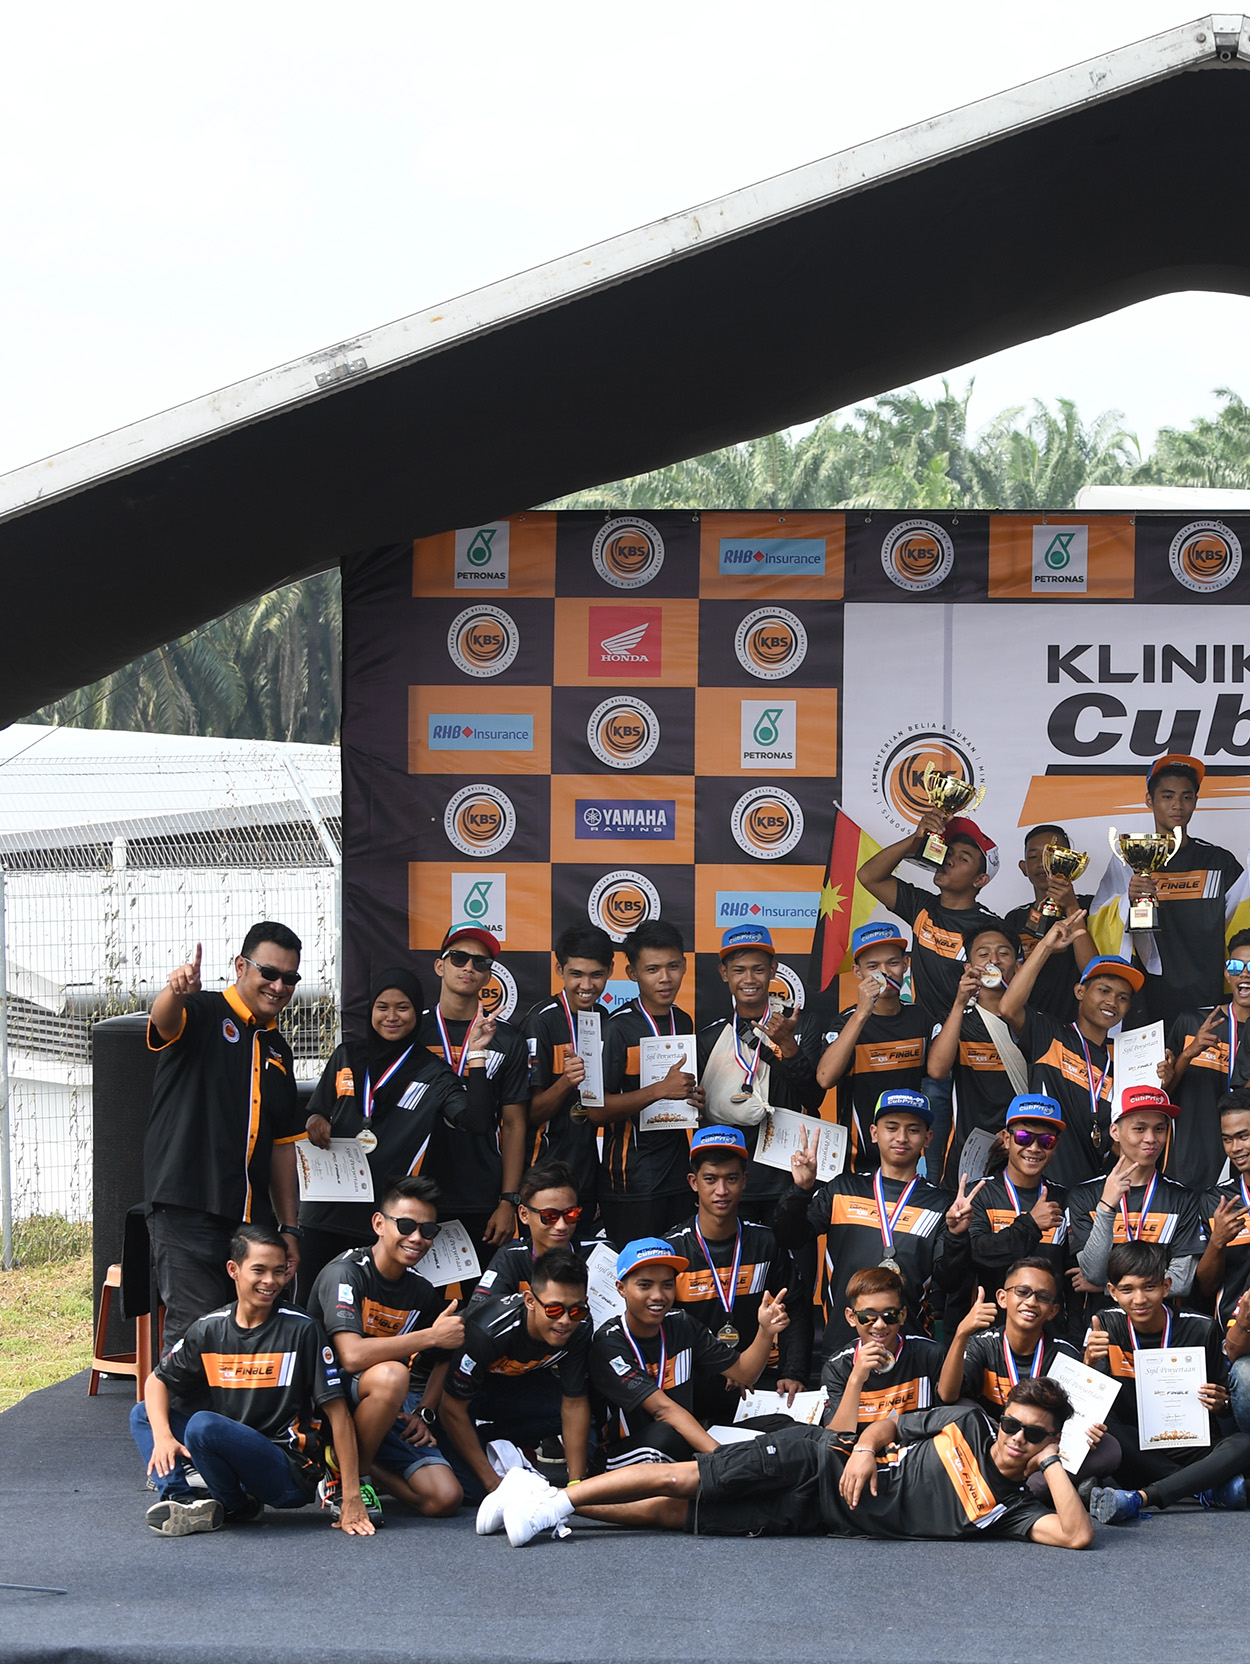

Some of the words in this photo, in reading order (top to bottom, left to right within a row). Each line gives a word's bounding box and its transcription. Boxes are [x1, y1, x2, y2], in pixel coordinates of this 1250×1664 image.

[618, 546, 645, 558] KBS
[724, 549, 753, 564] RHB
[765, 553, 821, 564] Insurance
[907, 549, 934, 561] KBS
[1195, 550, 1222, 562] KBS
[457, 572, 506, 580] PETRONAS
[1034, 575, 1084, 583] PETRONAS
[473, 635, 500, 647] KBS
[761, 637, 788, 649] KBS
[601, 654, 649, 662] HONDA
[433, 725, 461, 740] RHB
[474, 729, 529, 740] Insurance
[613, 726, 640, 738] KBS
[743, 751, 793, 760] PETRONAS
[872, 731, 905, 794] KEMENTERIAN
[908, 723, 937, 731] BELIA
[950, 728, 977, 753] SUKAN
[470, 814, 497, 826] KBS
[602, 809, 667, 826] YAMAHA
[757, 817, 784, 829] KBS
[881, 808, 912, 835] SPORTS
[614, 901, 641, 913] KBS
[720, 902, 749, 917] RHB
[762, 906, 818, 917] Insurance
[482, 988, 499, 998] BS
